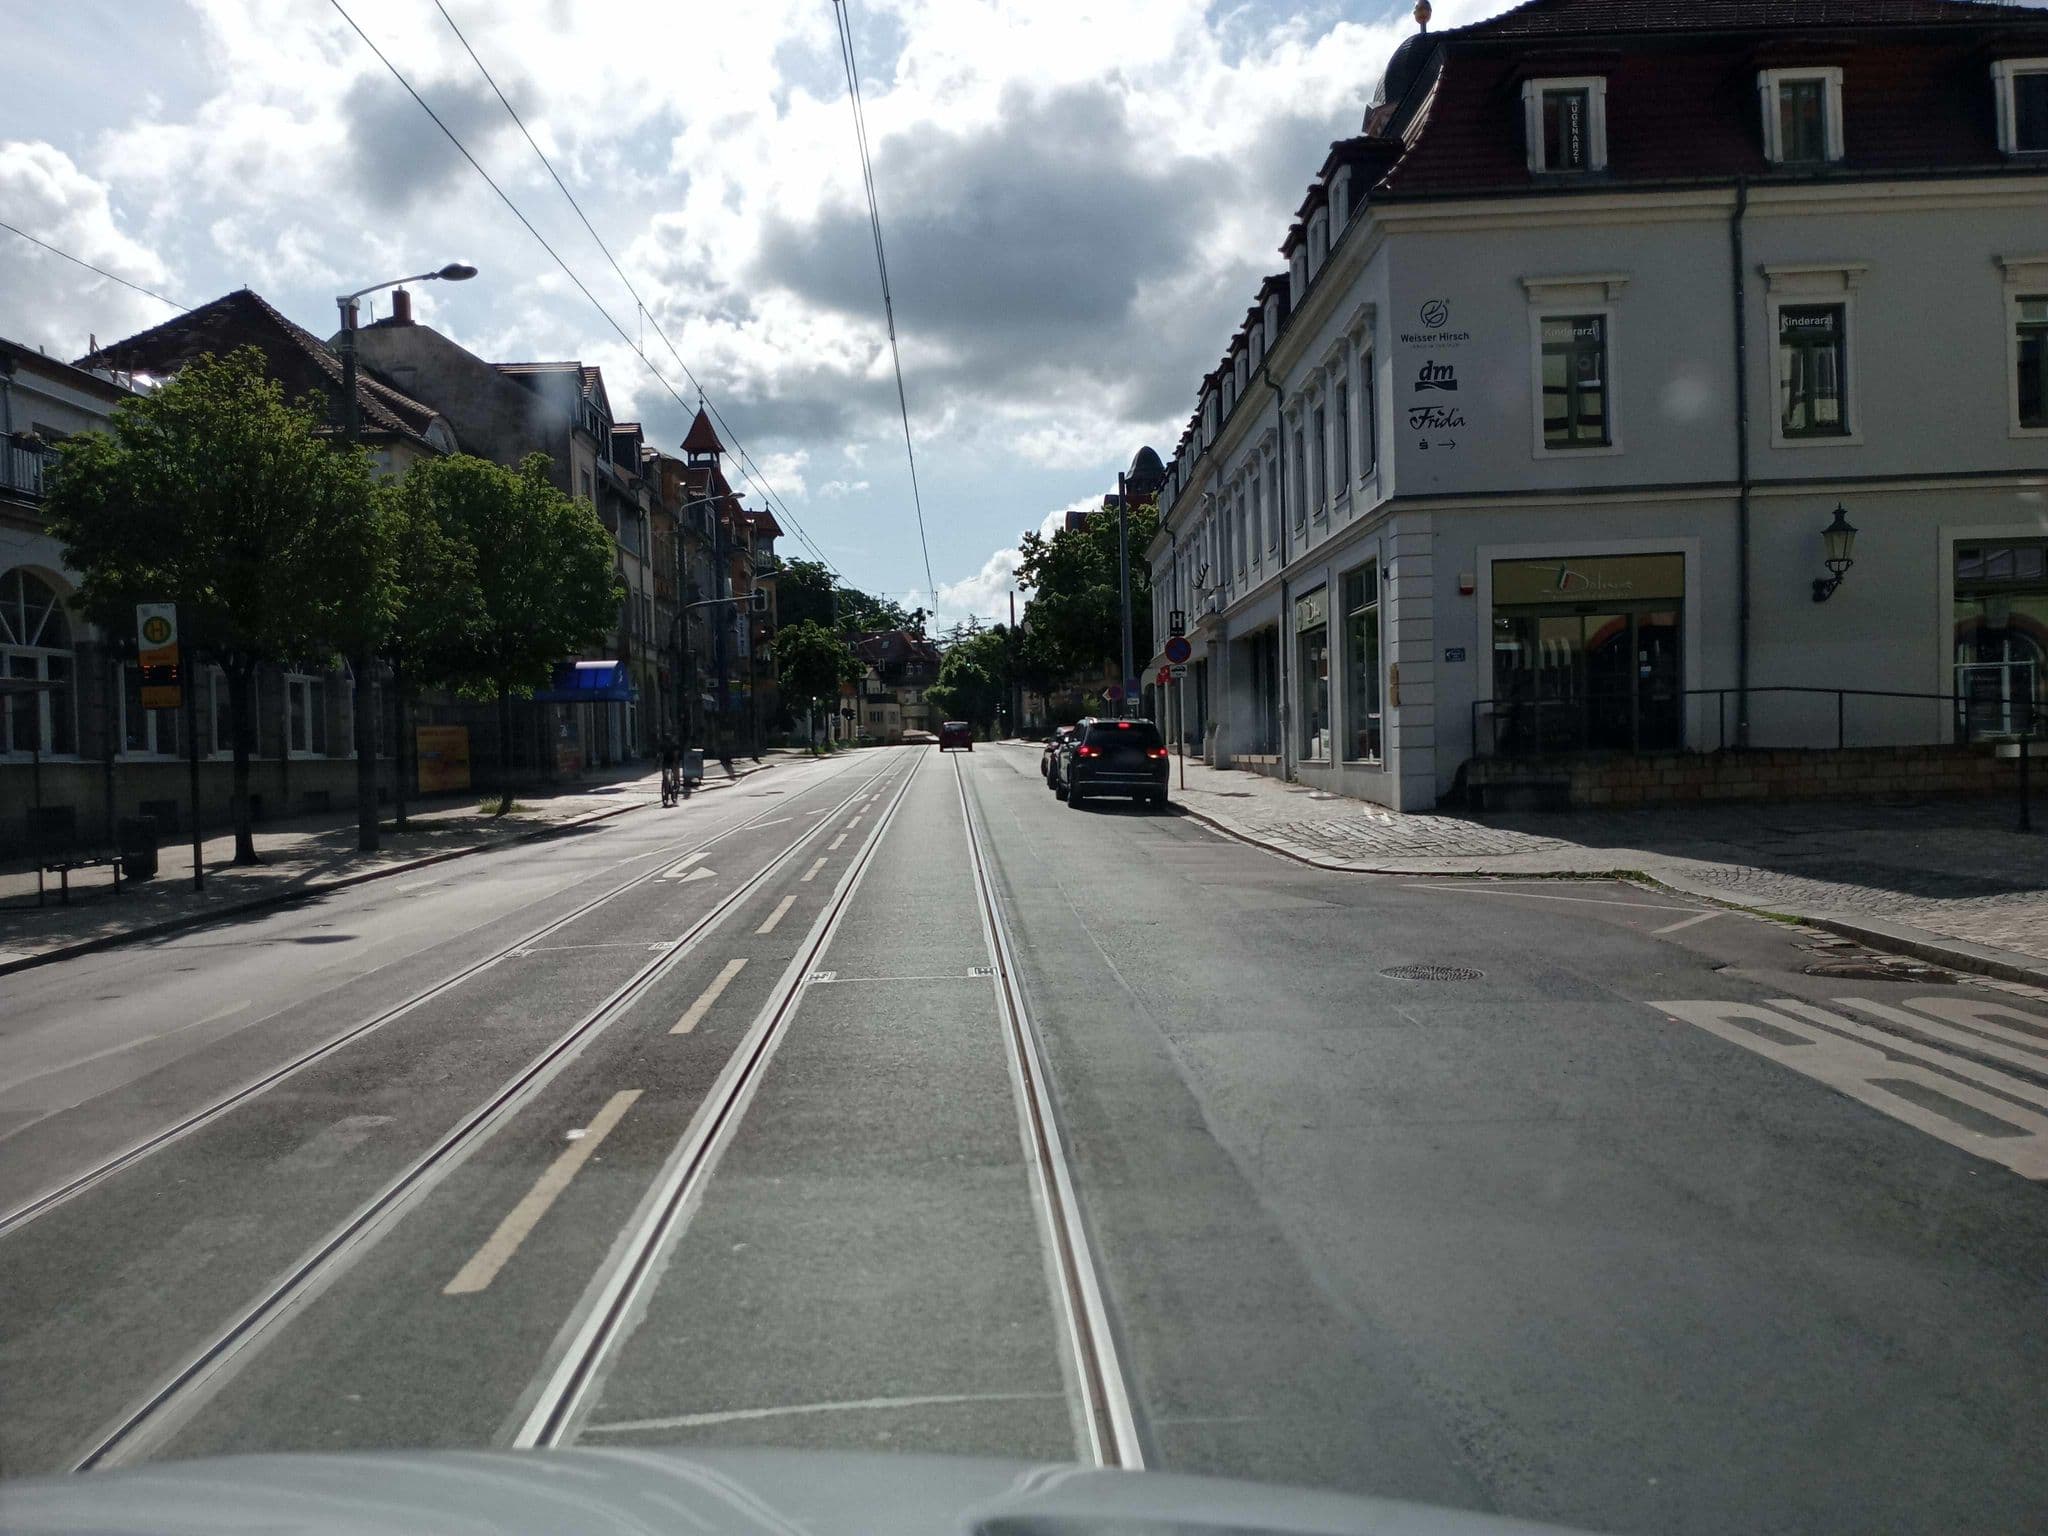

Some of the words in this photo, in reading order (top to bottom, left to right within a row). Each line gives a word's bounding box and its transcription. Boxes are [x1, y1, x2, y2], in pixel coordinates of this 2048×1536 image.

[1571, 98, 1580, 164] AUGENARZT
[1400, 333, 1438, 344] Weisser
[1439, 331, 1470, 342] Hirsch
[1419, 360, 1454, 381] dm
[1408, 406, 1466, 430] Frida
[151, 620, 164, 641] H
[1172, 612, 1183, 628] H
